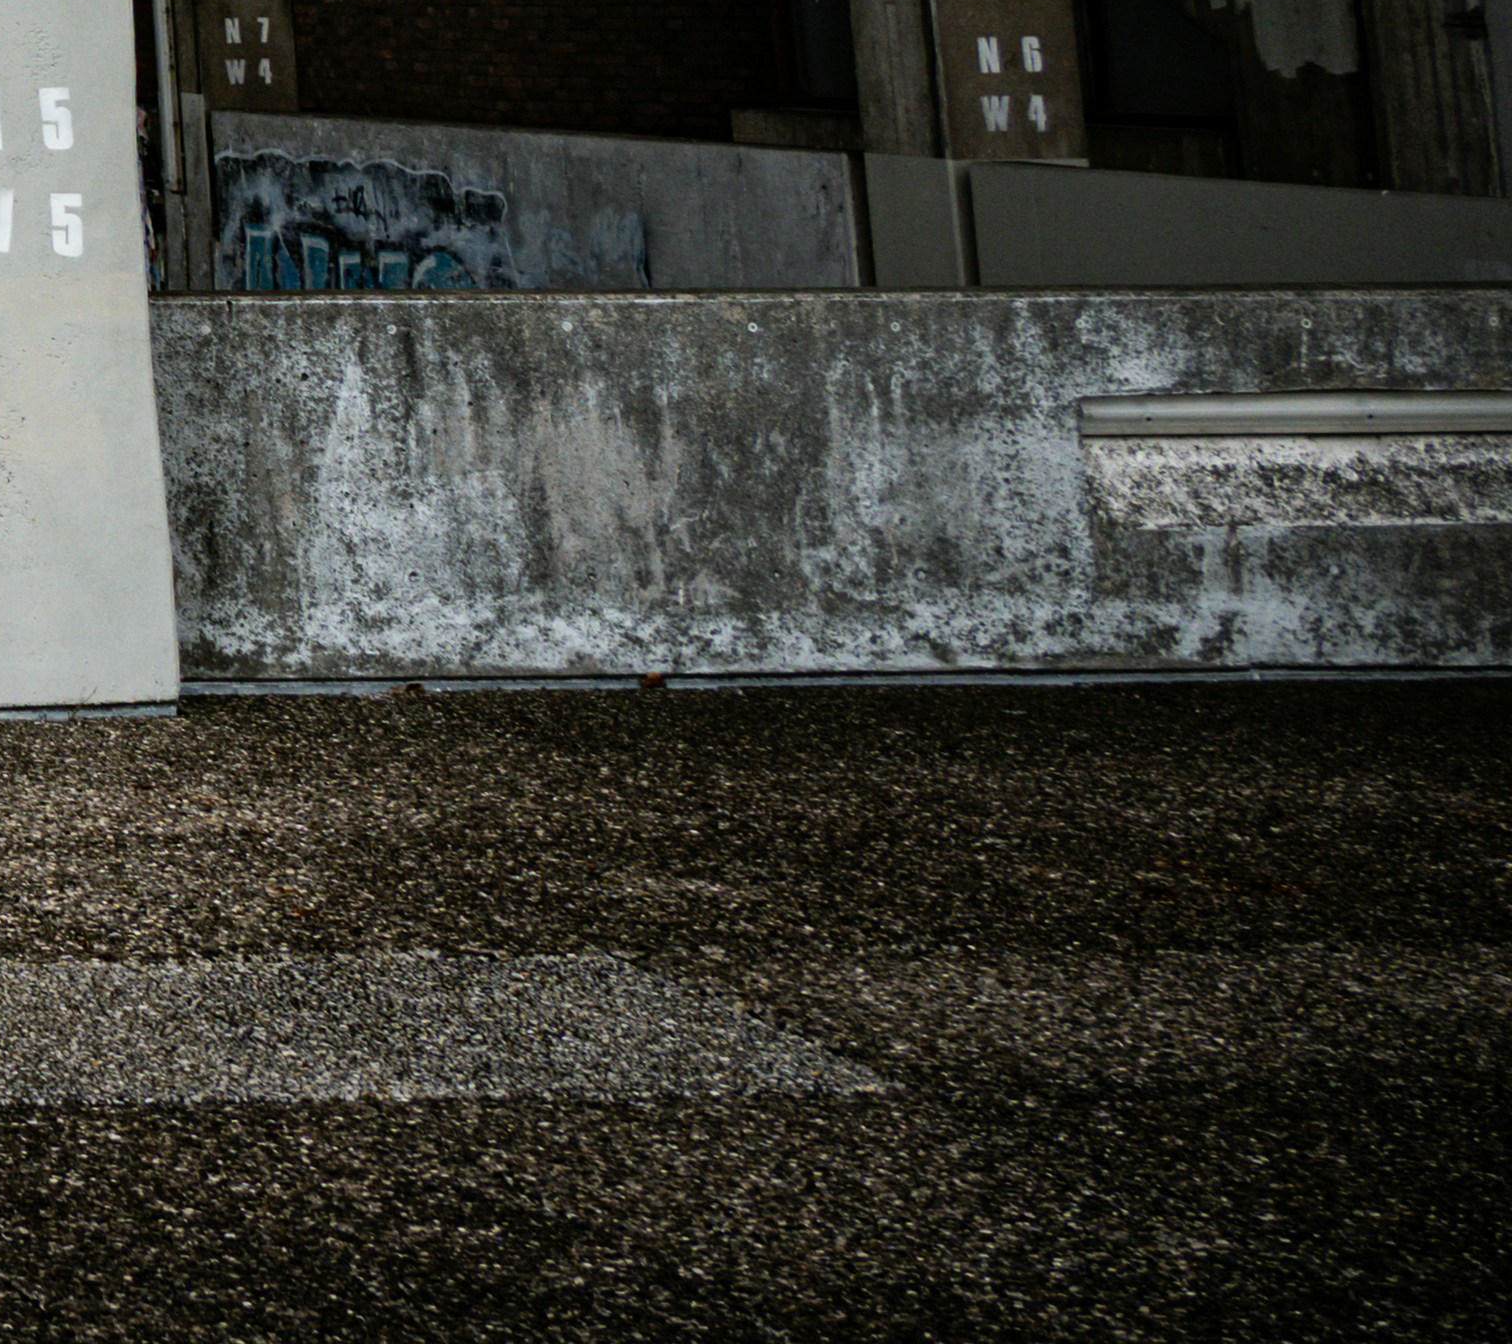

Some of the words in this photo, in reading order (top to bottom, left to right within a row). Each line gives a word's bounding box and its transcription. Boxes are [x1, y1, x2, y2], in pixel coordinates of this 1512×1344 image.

[225, 18, 241, 43] N
[257, 17, 269, 43] 7
[225, 59, 245, 84] W
[259, 59, 272, 84] 4
[978, 37, 1000, 73] N
[1022, 36, 1042, 72] 6
[39, 87, 73, 150] 5
[981, 96, 1009, 131] W
[1029, 95, 1047, 131] 4
[50, 194, 83, 257] 5
